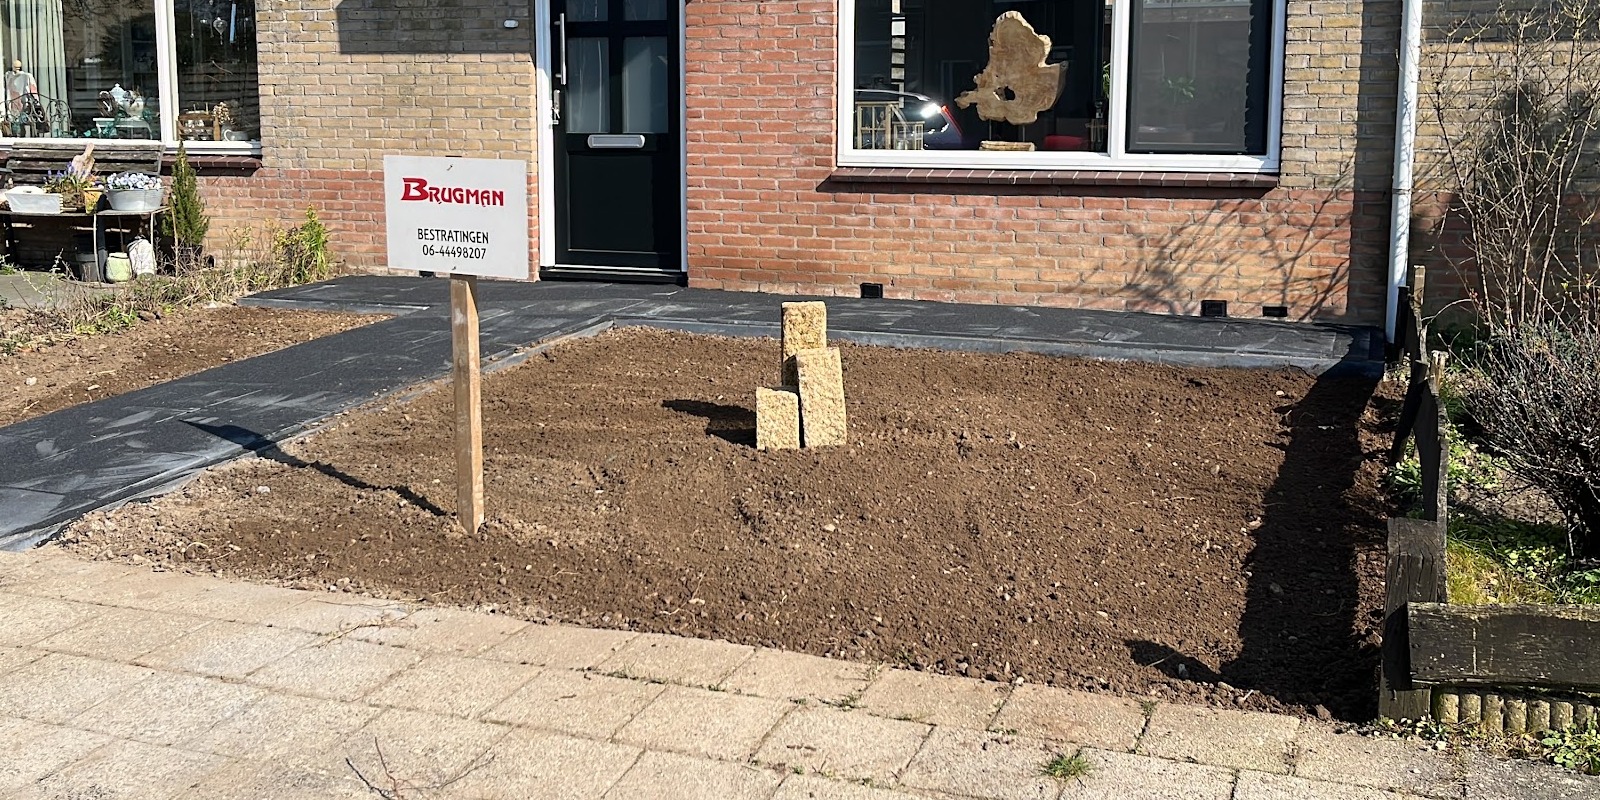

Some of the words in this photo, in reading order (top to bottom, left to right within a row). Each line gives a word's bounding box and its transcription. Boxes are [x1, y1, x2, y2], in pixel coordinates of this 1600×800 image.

[401, 177, 504, 207] BRUGMAN
[417, 228, 489, 244] BESTRATINGEN
[422, 244, 487, 259] 06-44498207
